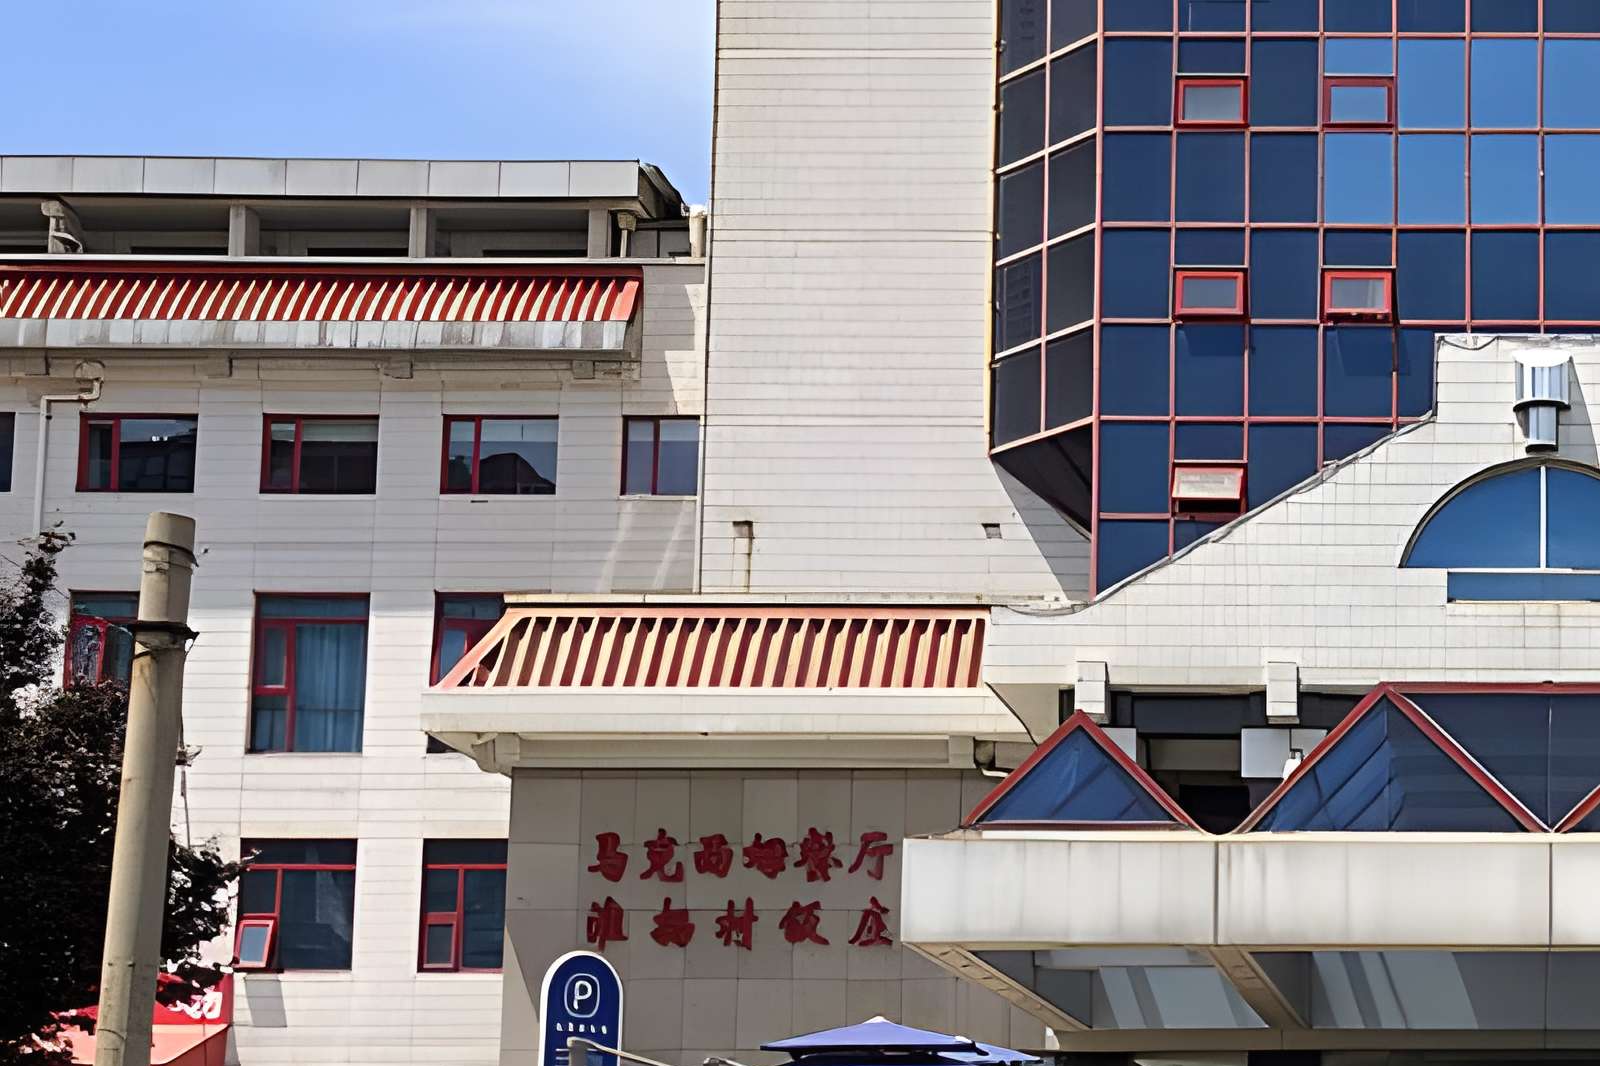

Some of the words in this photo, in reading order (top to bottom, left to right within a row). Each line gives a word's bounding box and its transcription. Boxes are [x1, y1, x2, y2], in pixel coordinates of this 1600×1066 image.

[587, 828, 894, 883] 马克西姆餐厅
[573, 980, 592, 1010] P
